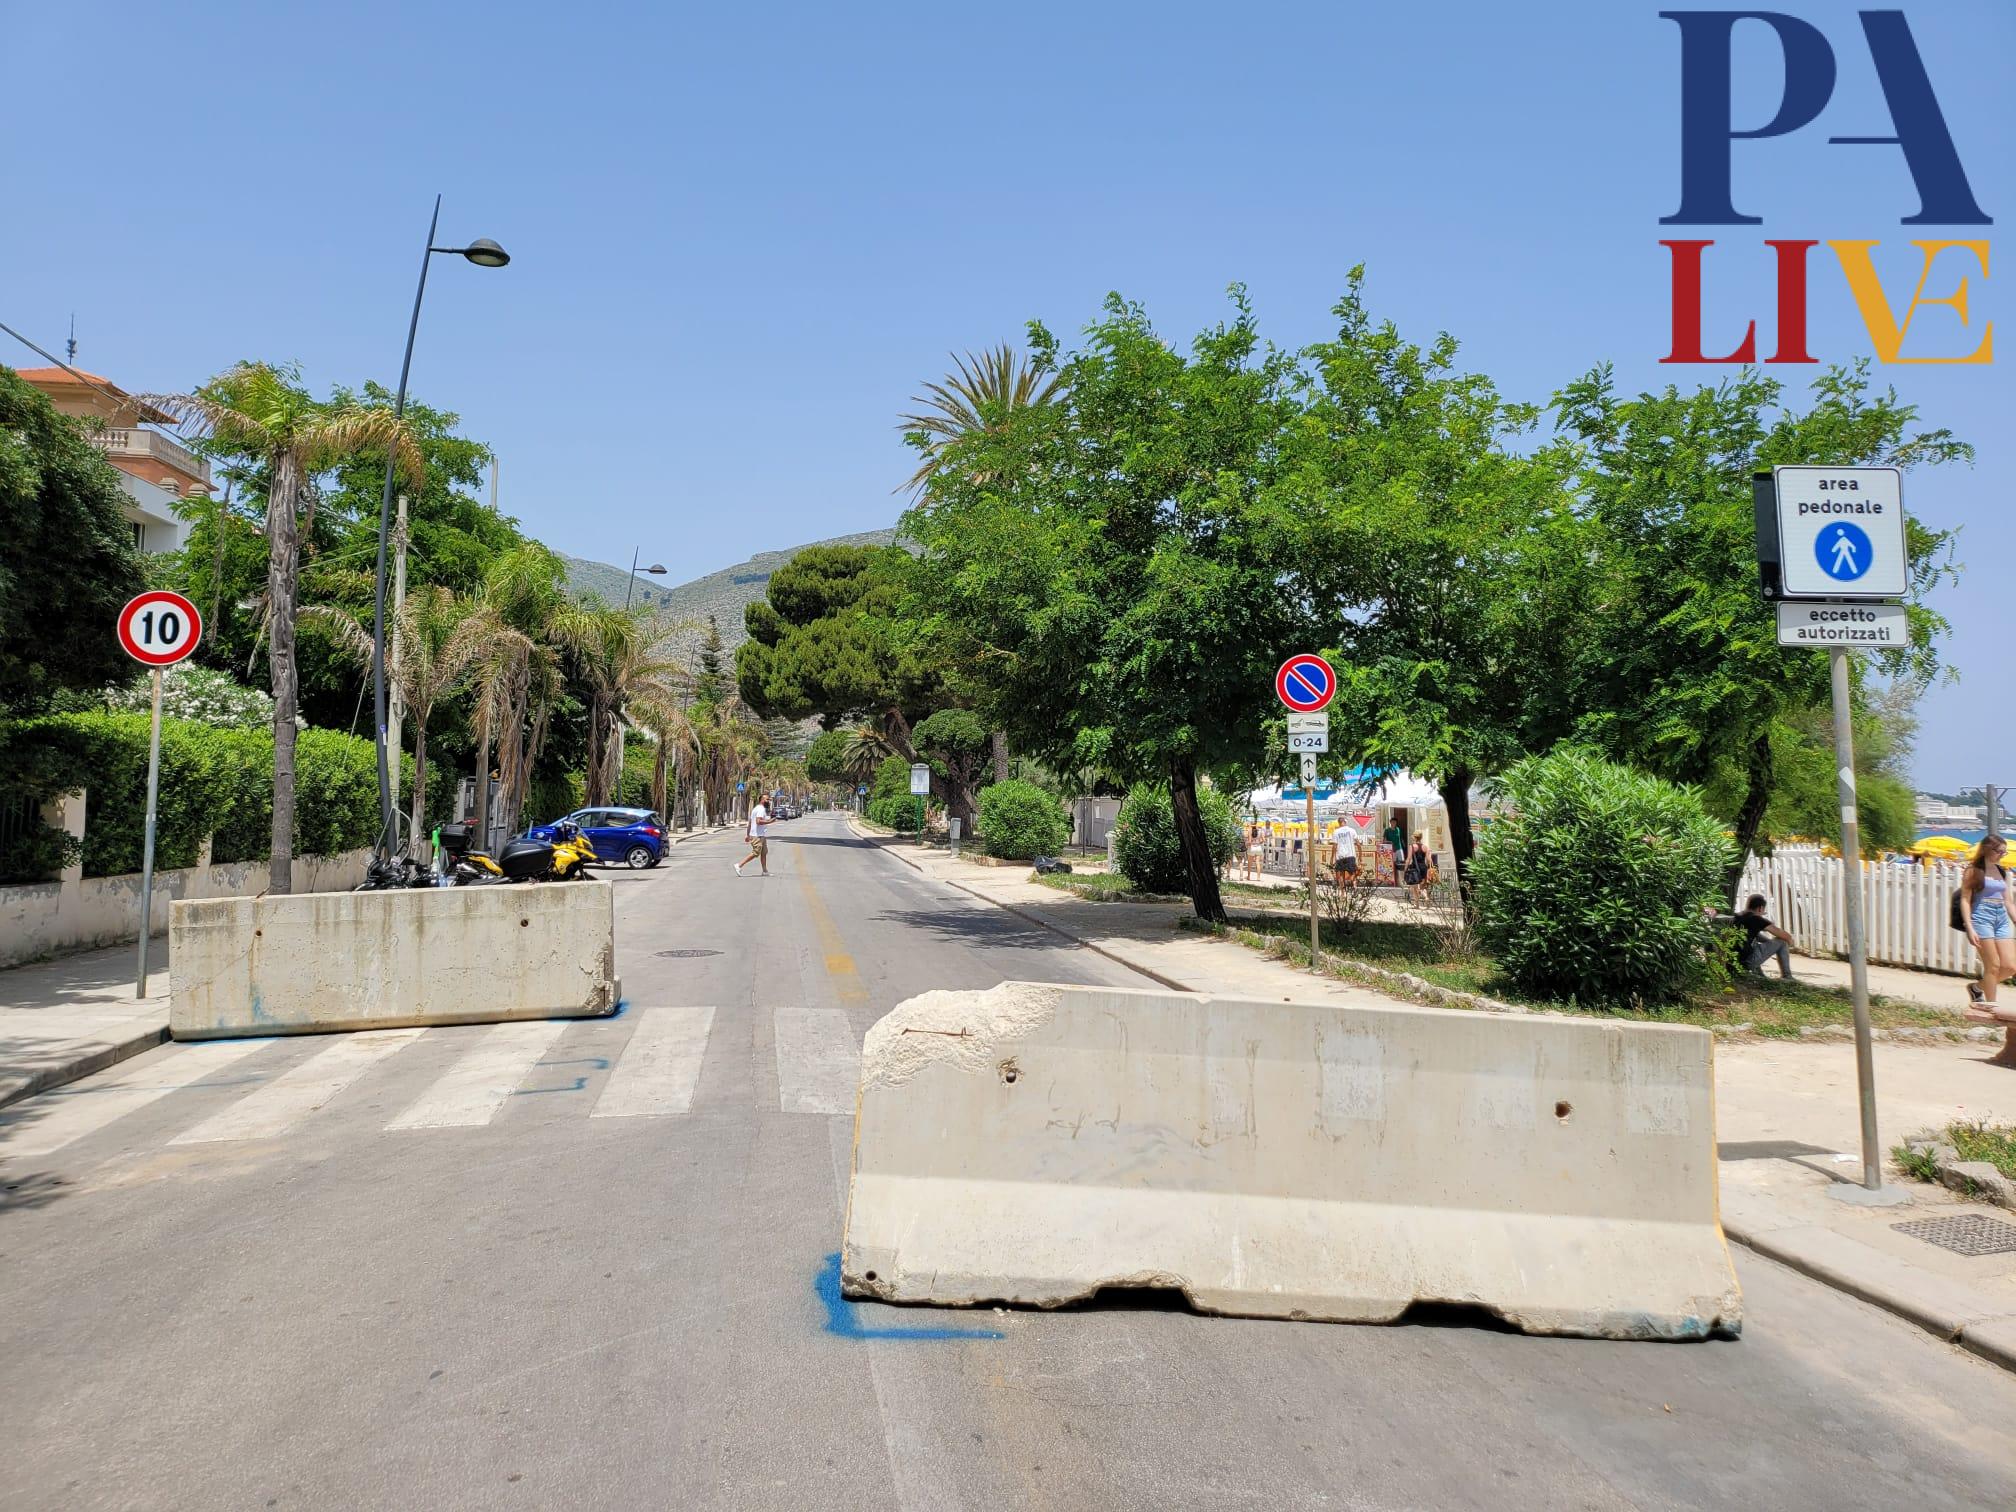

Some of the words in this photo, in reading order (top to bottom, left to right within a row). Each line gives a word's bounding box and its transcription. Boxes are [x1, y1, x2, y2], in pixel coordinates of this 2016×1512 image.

[1818, 478, 1859, 491] area
[1798, 499, 1883, 516] pedonale
[1809, 608, 1876, 623] eccetto
[142, 611, 180, 645] 10
[1797, 625, 1891, 642] autorizzati
[1293, 737, 1323, 747] 0-24
